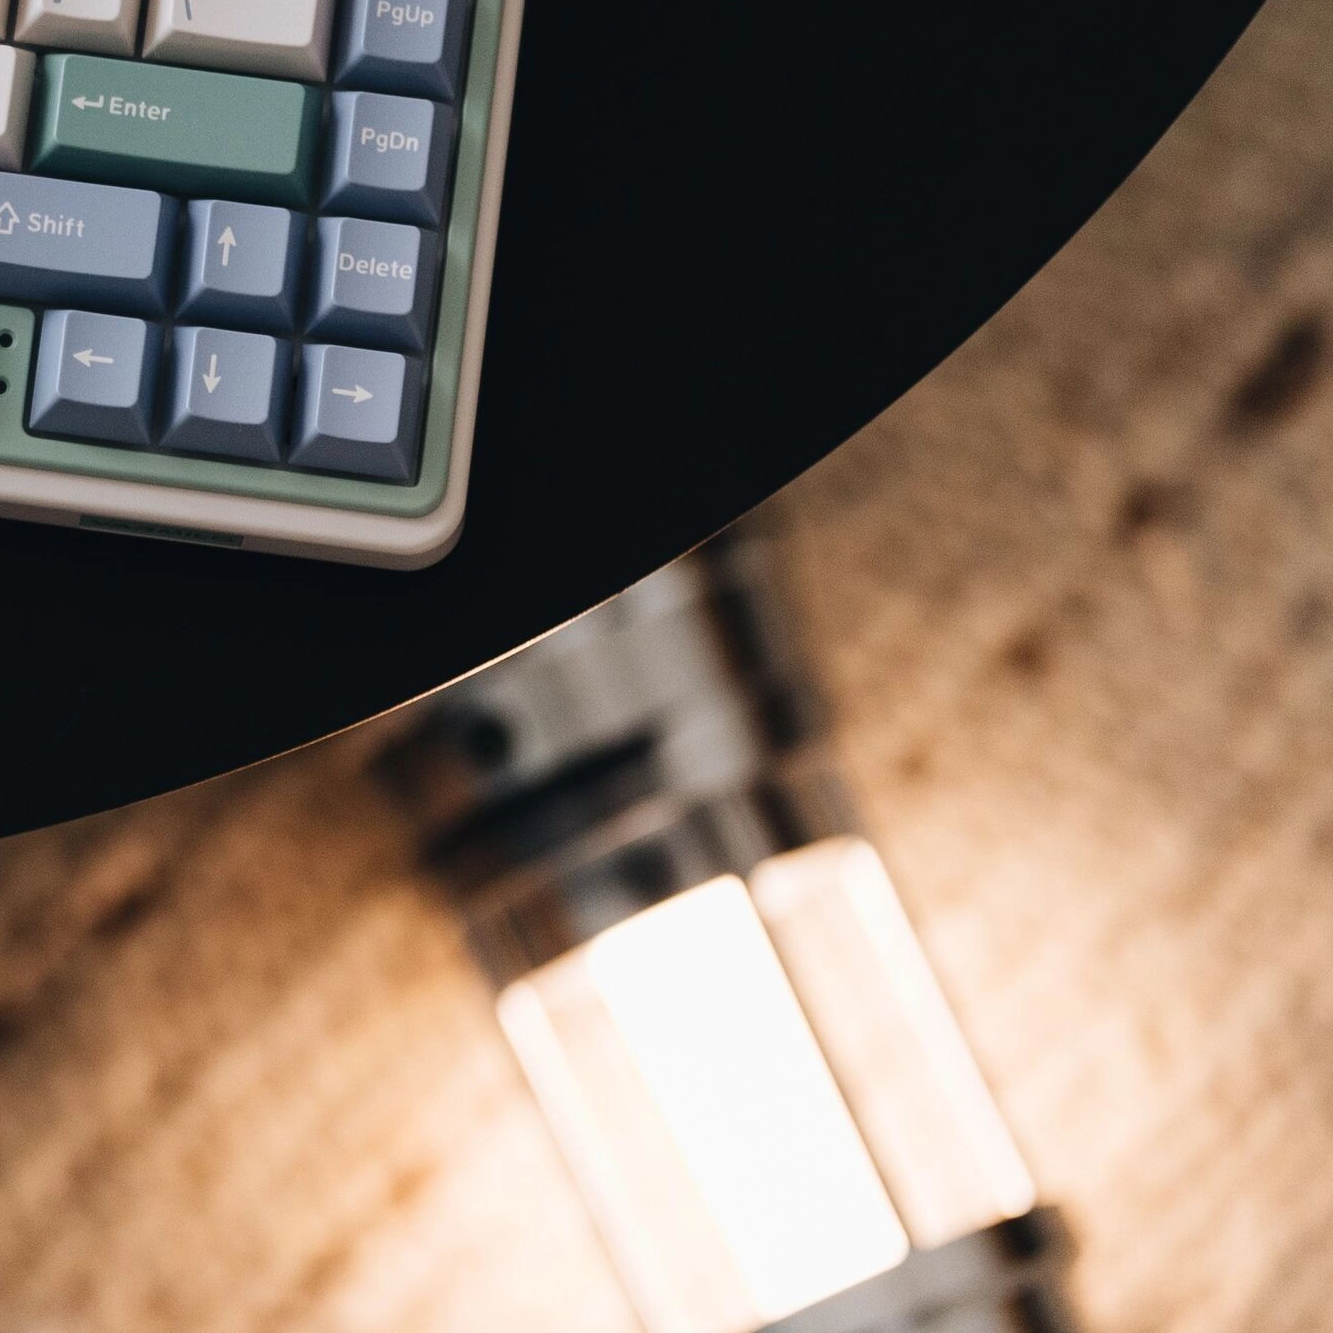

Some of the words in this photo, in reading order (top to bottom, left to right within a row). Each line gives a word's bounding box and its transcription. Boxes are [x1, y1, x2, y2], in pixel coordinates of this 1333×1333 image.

[377, 0, 434, 27] PgUp
[109, 96, 171, 120] Enter
[361, 127, 418, 153] PgDn
[27, 213, 84, 237] Shift
[337, 252, 415, 281] Delete
